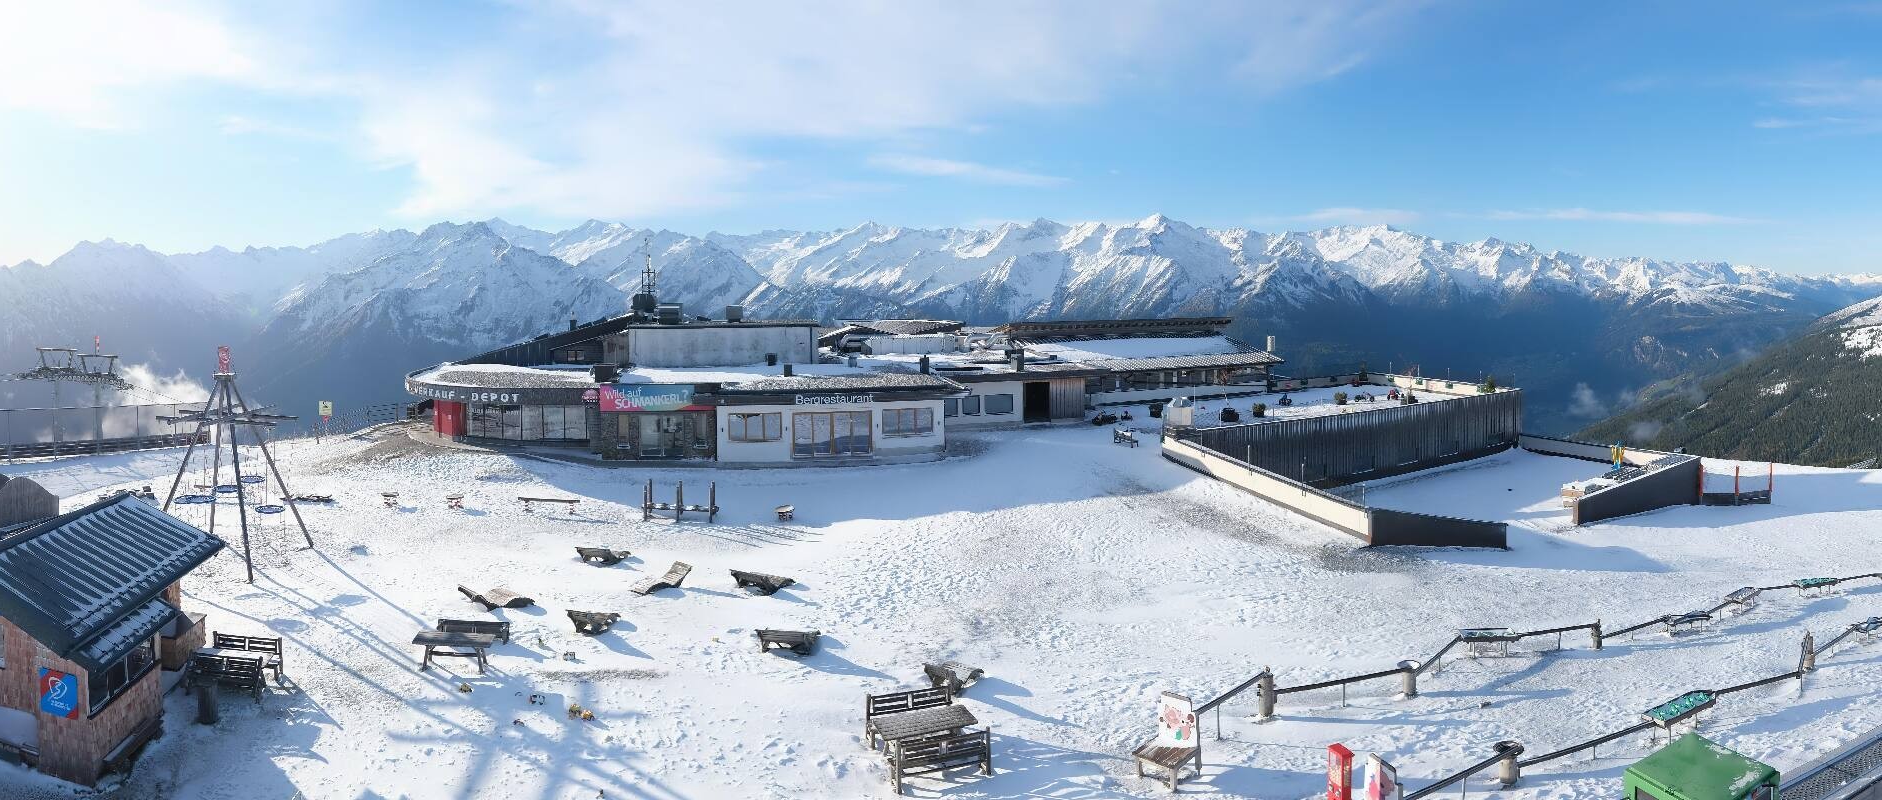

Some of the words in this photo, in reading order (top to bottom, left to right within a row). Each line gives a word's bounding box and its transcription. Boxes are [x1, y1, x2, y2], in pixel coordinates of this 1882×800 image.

[415, 386, 455, 399] VERKAUF
[471, 392, 520, 403] DEPOT
[604, 389, 625, 400] Wild
[627, 387, 642, 398] auf
[614, 390, 689, 409] SCHMANKERL?
[795, 394, 874, 405] Bergrestaurant
